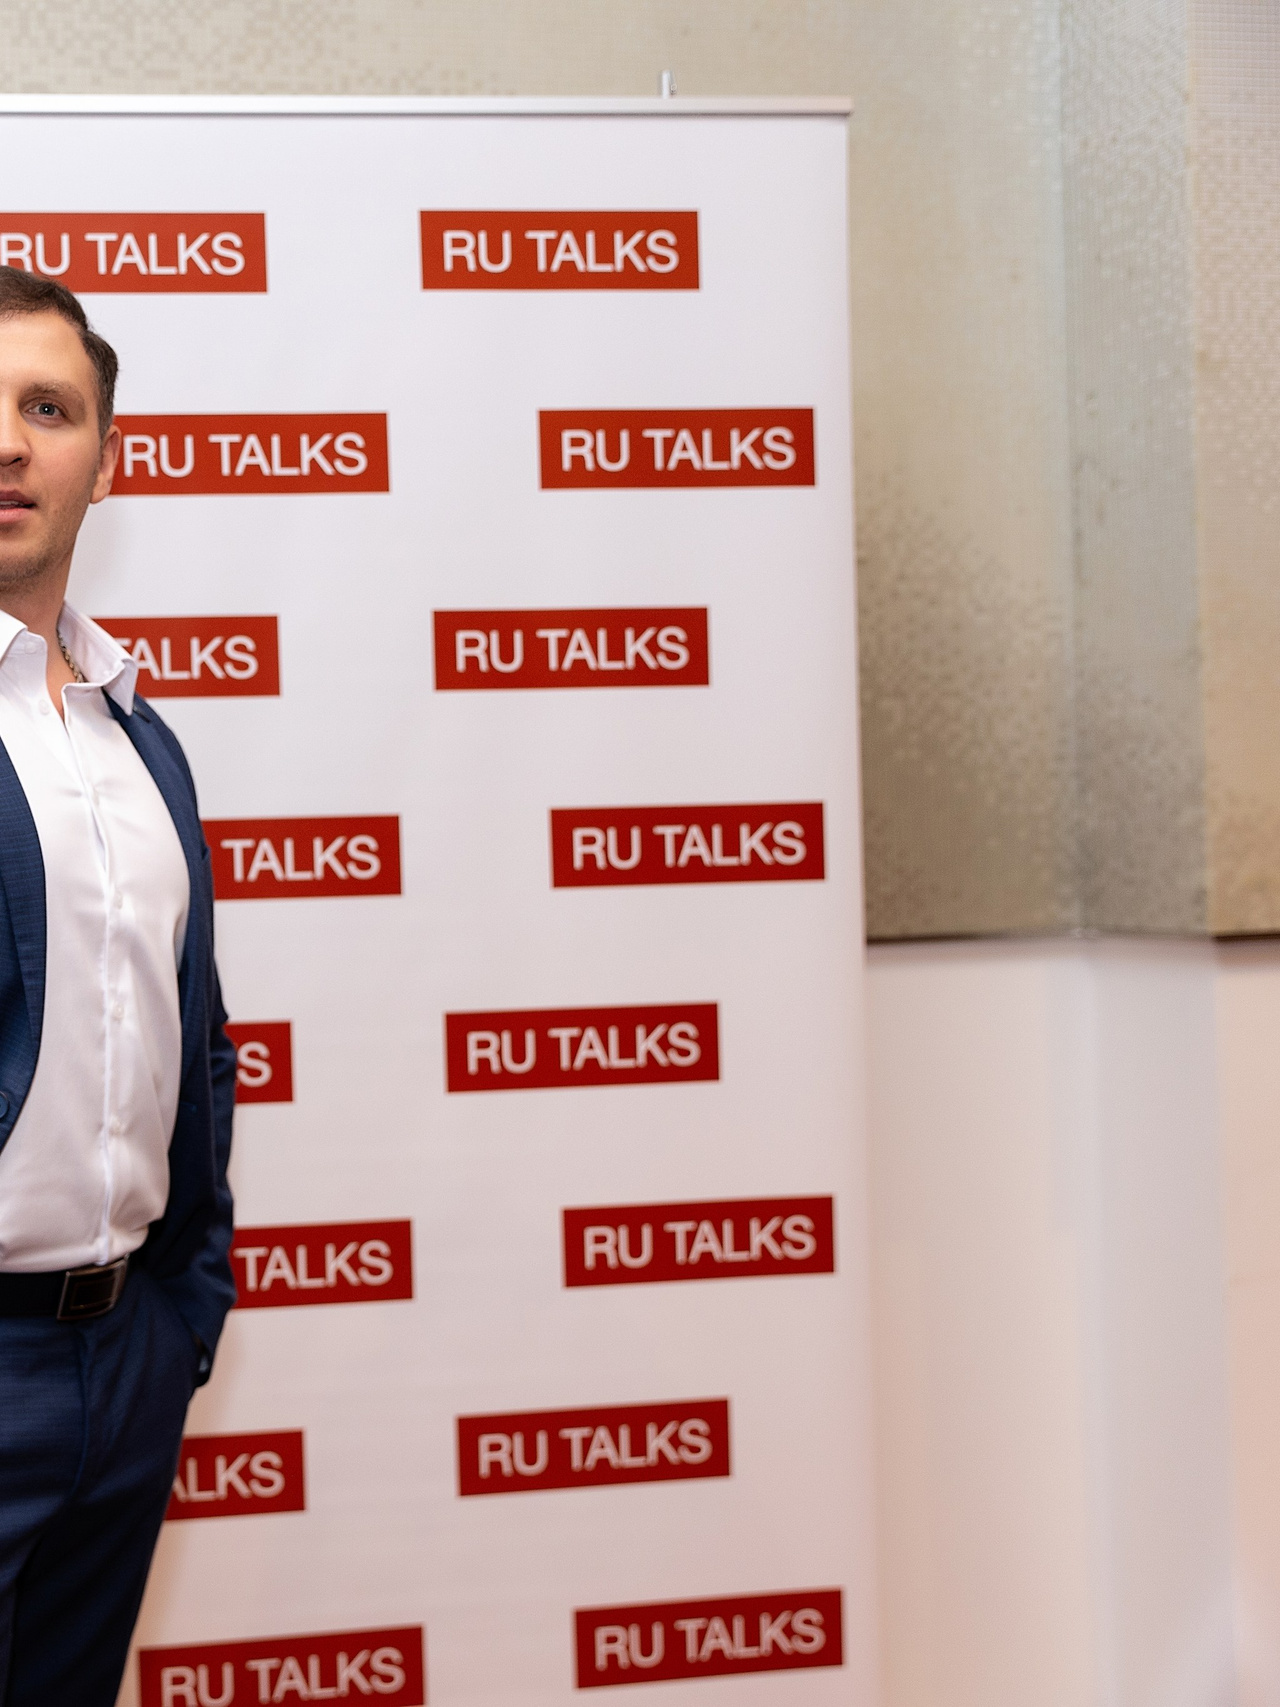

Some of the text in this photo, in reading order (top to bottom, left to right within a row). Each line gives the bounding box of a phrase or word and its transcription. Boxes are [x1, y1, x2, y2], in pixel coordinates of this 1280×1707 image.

[83, 231, 246, 276] TALKS
[442, 229, 680, 274] RU TALKS
[123, 431, 368, 478] RU TALKS
[561, 426, 796, 473] RU TALKS
[114, 635, 260, 681] ALKS
[455, 626, 689, 674] RU TALKS
[220, 835, 381, 883] TALKS
[572, 821, 805, 871] RU TALKS
[467, 1022, 700, 1074] RU TALKS
[233, 1240, 392, 1291] TALKS
[584, 1215, 815, 1269] RU TALKS
[478, 1419, 711, 1477] RU TALKS
[595, 1608, 824, 1668] RU TALKS
[160, 1647, 406, 1707] RU TALKS
